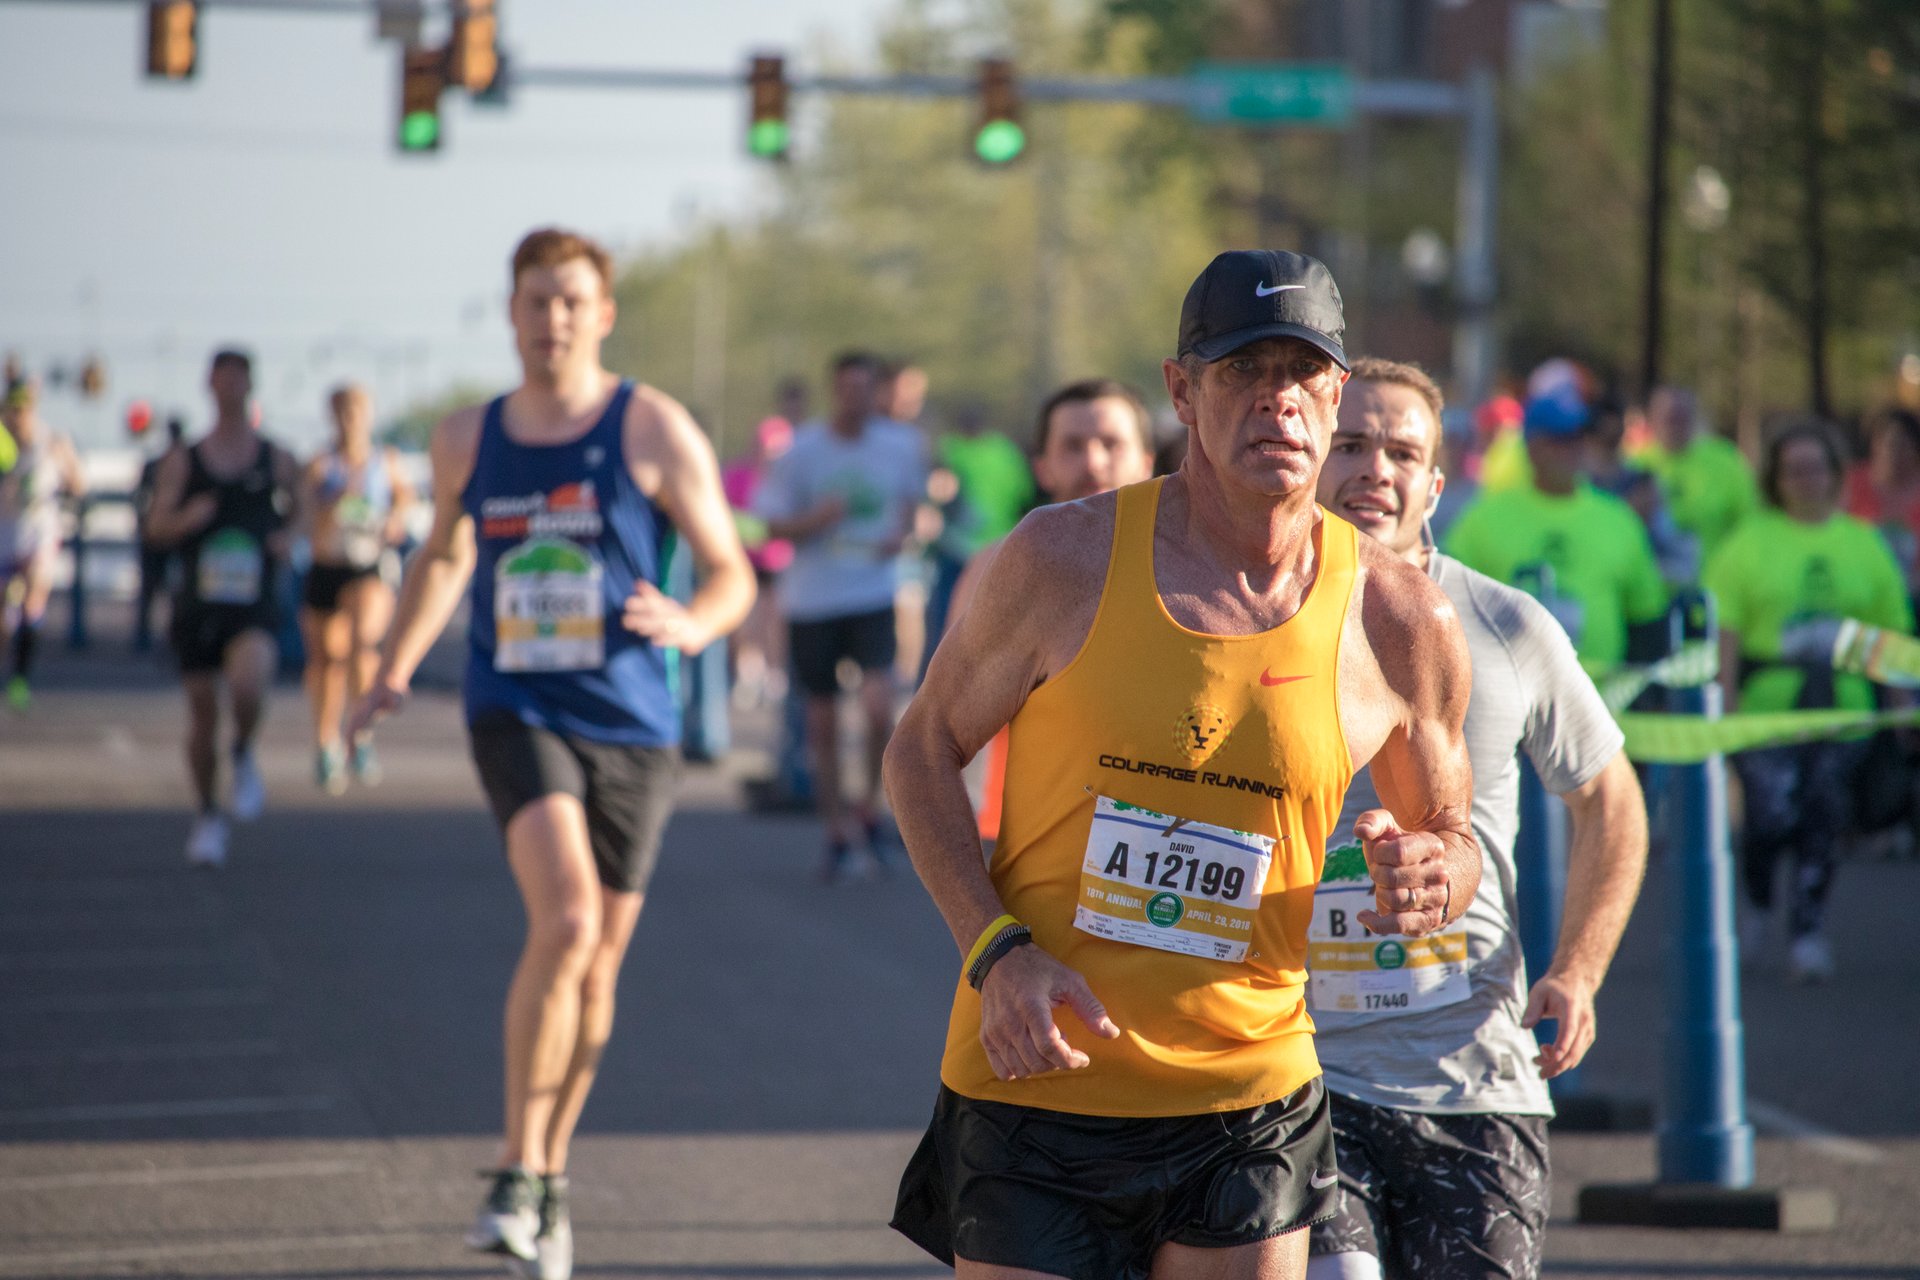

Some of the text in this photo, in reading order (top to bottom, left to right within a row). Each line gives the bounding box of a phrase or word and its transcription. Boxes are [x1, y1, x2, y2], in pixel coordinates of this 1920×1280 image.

[1099, 754, 1285, 800] COURAGE RUNNING
[1169, 841, 1195, 855] DAVID
[1104, 841, 1246, 900] A 12199
[1105, 892, 1143, 909] ANNUAL
[1186, 909, 1212, 923] APRIL
[1329, 908, 1347, 938] B
[1365, 992, 1409, 1010] 17440
